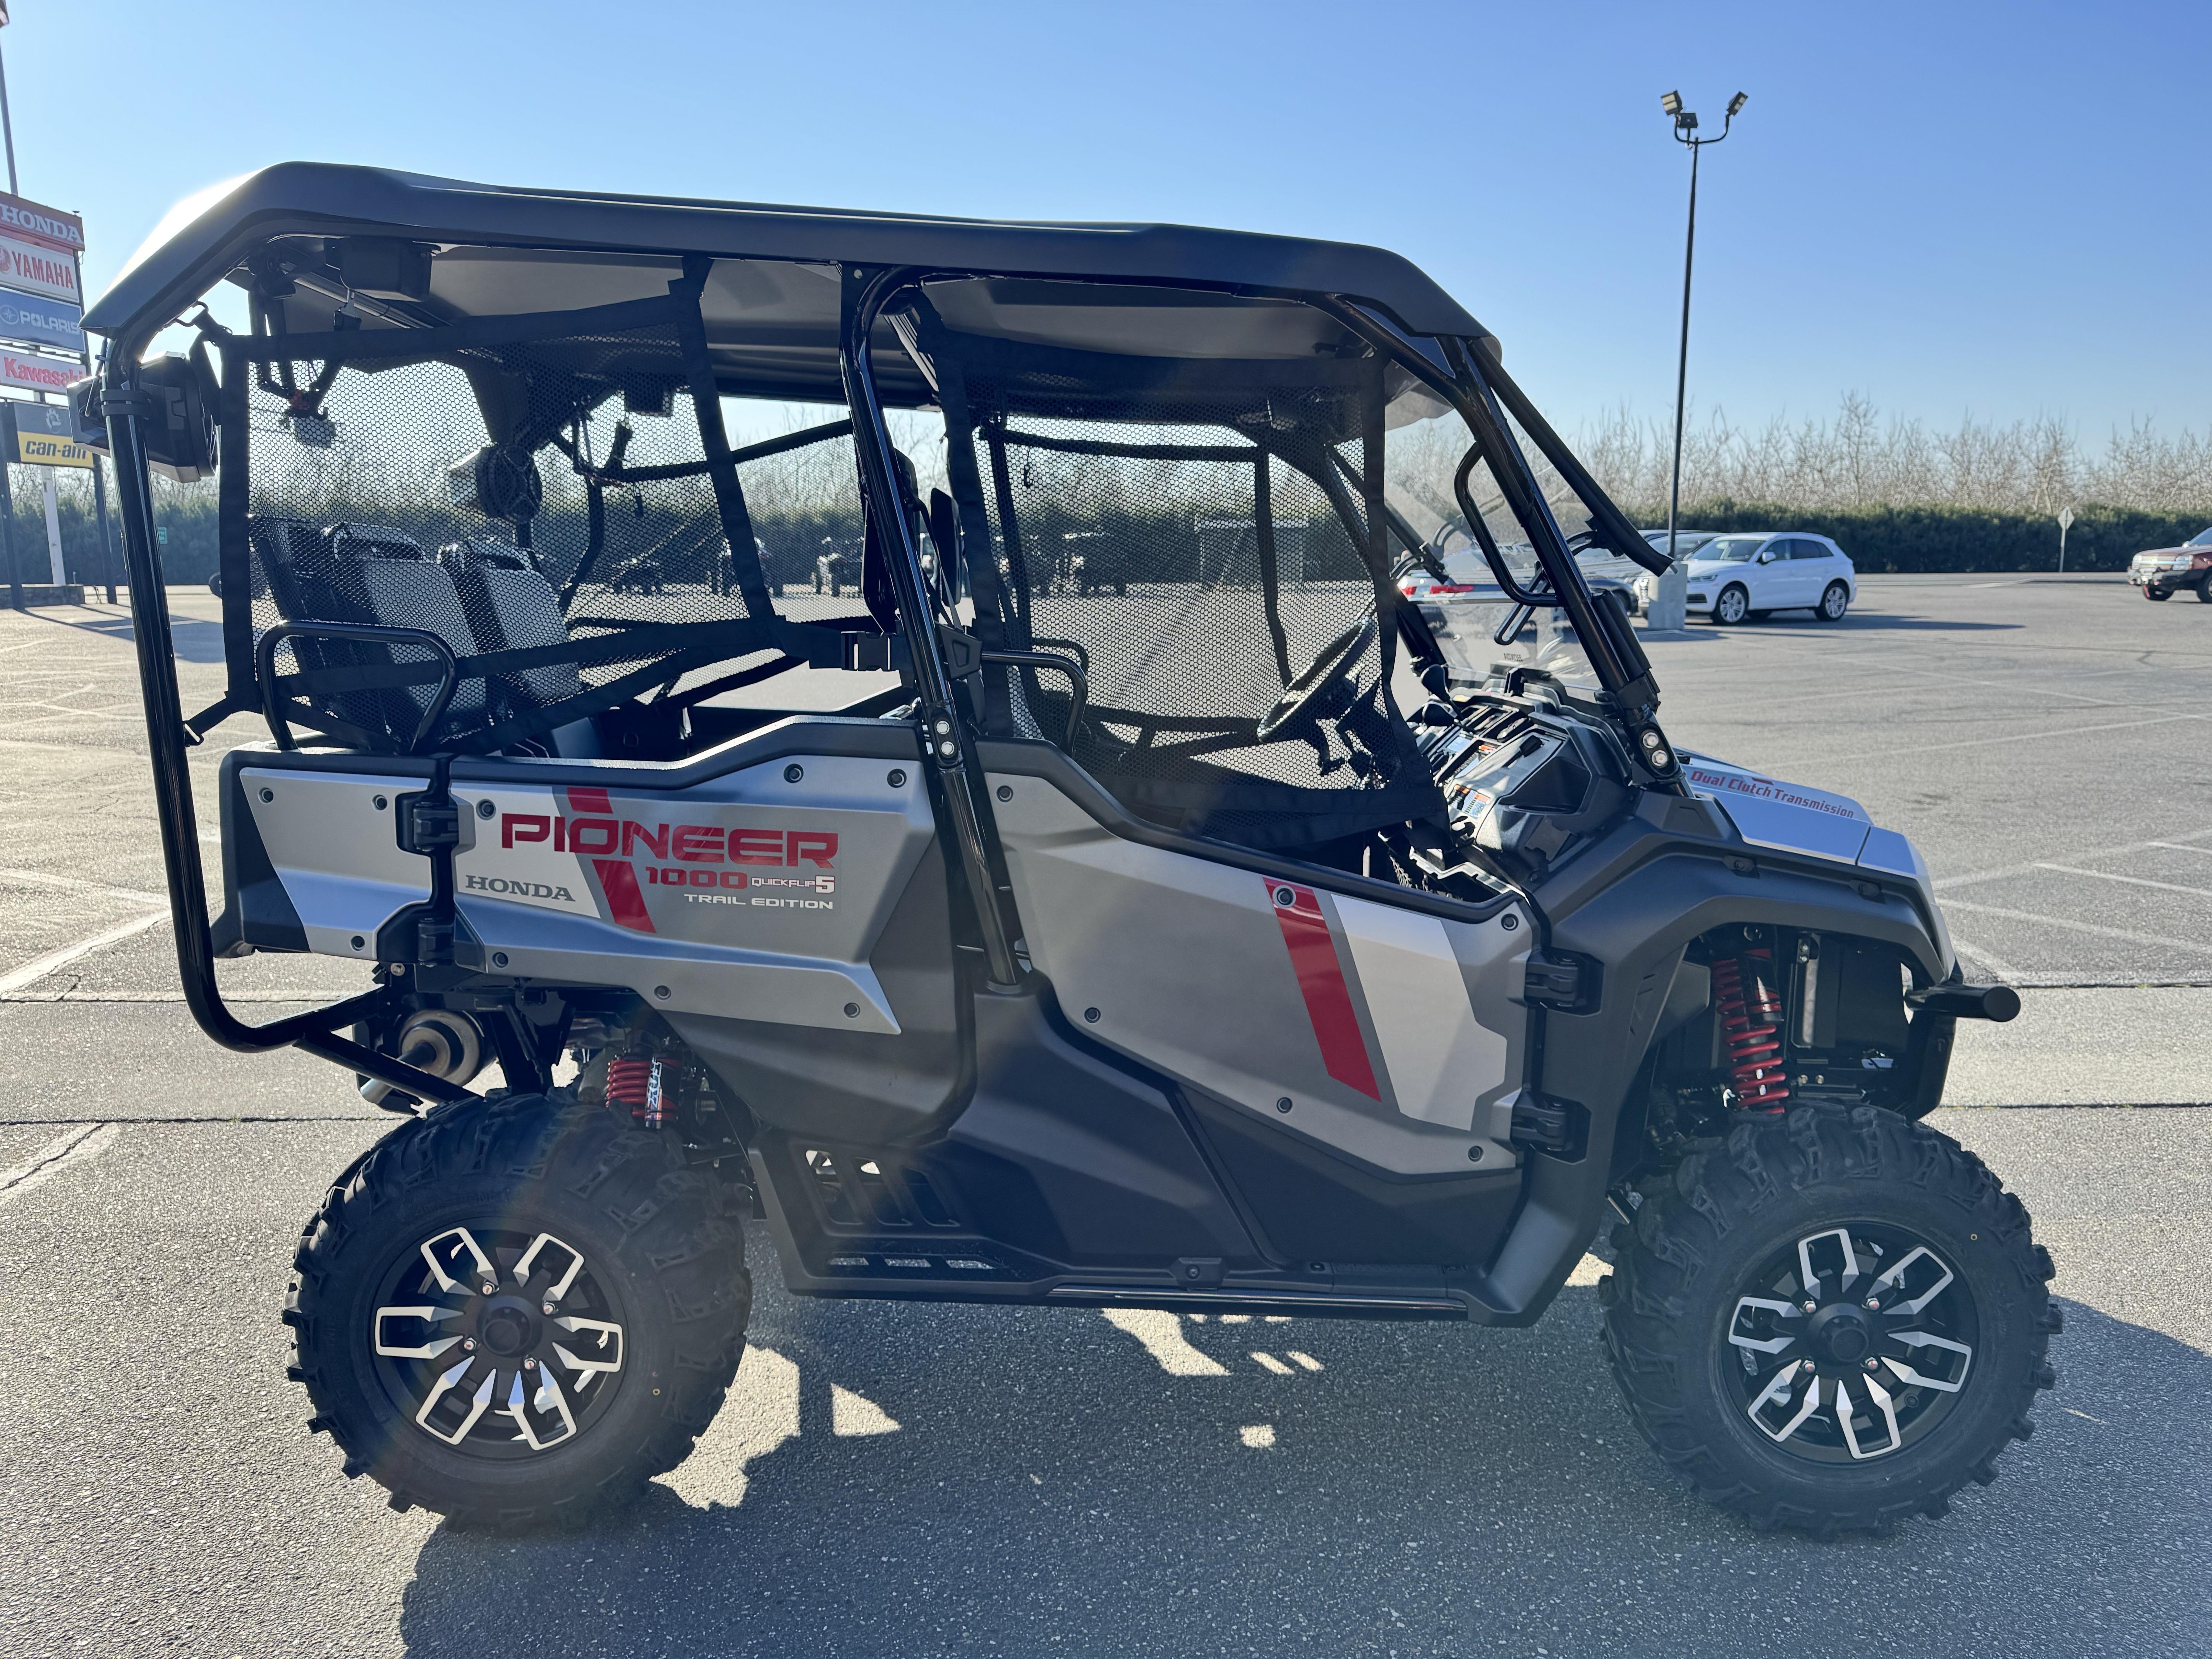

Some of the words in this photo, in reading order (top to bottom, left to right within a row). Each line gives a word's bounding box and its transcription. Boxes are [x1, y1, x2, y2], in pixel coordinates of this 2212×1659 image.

[0, 203, 83, 244] HONDA
[12, 251, 74, 289] YAMAHA
[20, 311, 80, 335] POLARIS
[1690, 770, 1725, 787] Dual
[1728, 778, 1771, 797] Clutch
[1774, 789, 1854, 818] Transmission
[502, 813, 838, 868] PIONEER
[465, 875, 575, 902] HONDA
[646, 867, 747, 889] 1000
[684, 894, 746, 905] TRAIL
[751, 898, 833, 909] EDITION
